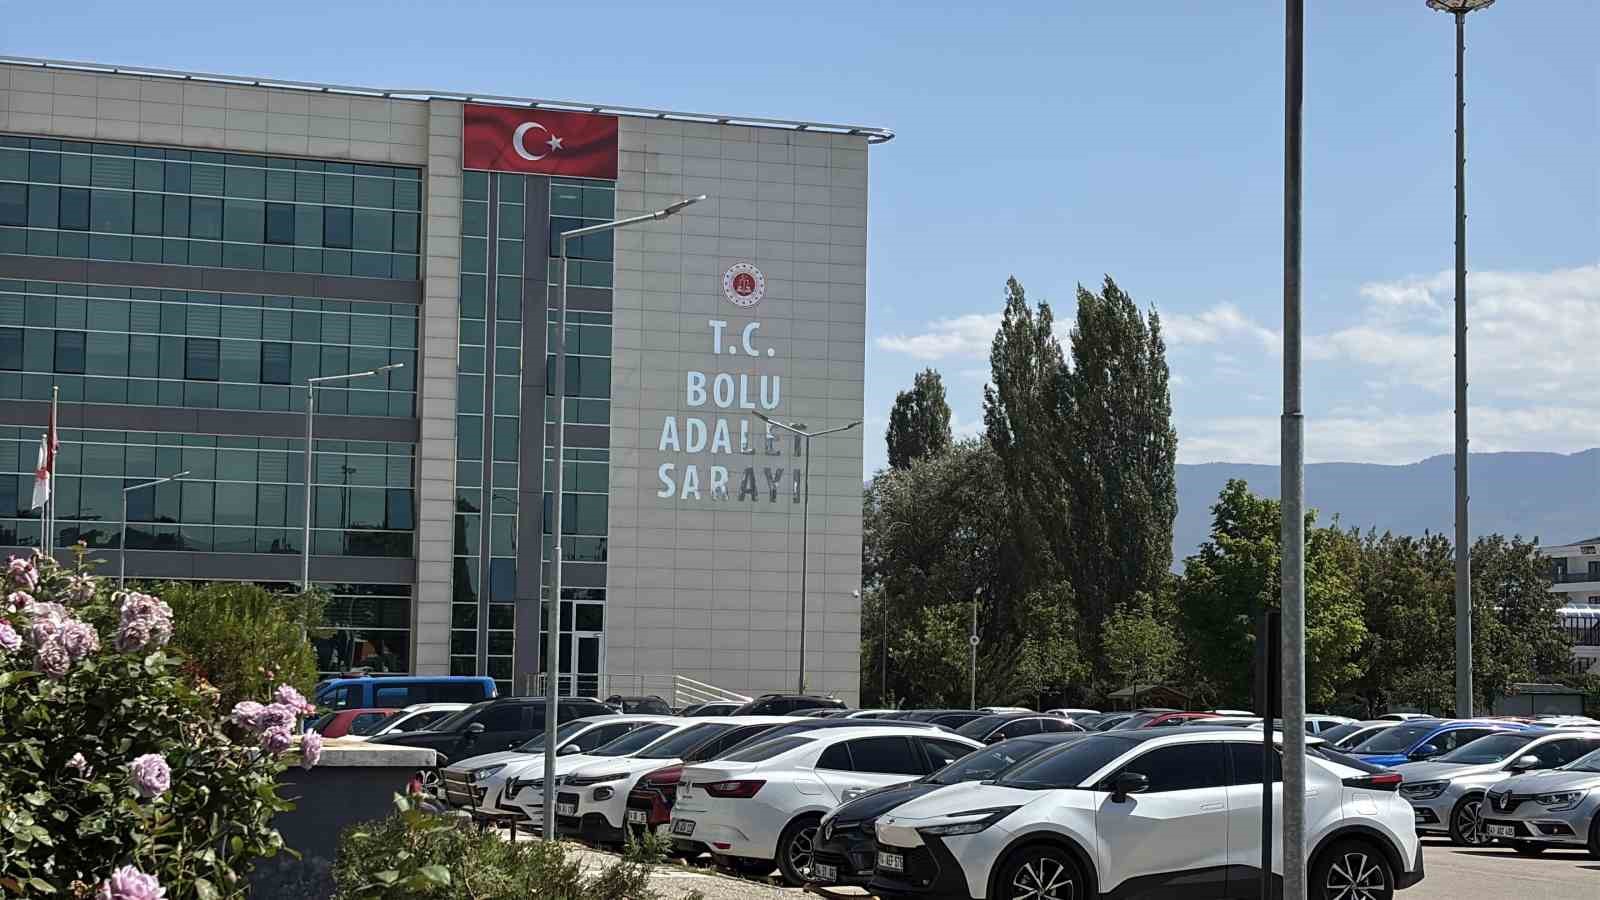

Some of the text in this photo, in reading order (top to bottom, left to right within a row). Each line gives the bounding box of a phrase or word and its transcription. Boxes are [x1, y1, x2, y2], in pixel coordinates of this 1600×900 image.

[708, 319, 776, 357] T.C.
[687, 371, 780, 409] BOLU
[658, 415, 807, 457] ADALET
[657, 462, 801, 504] SARAYI
